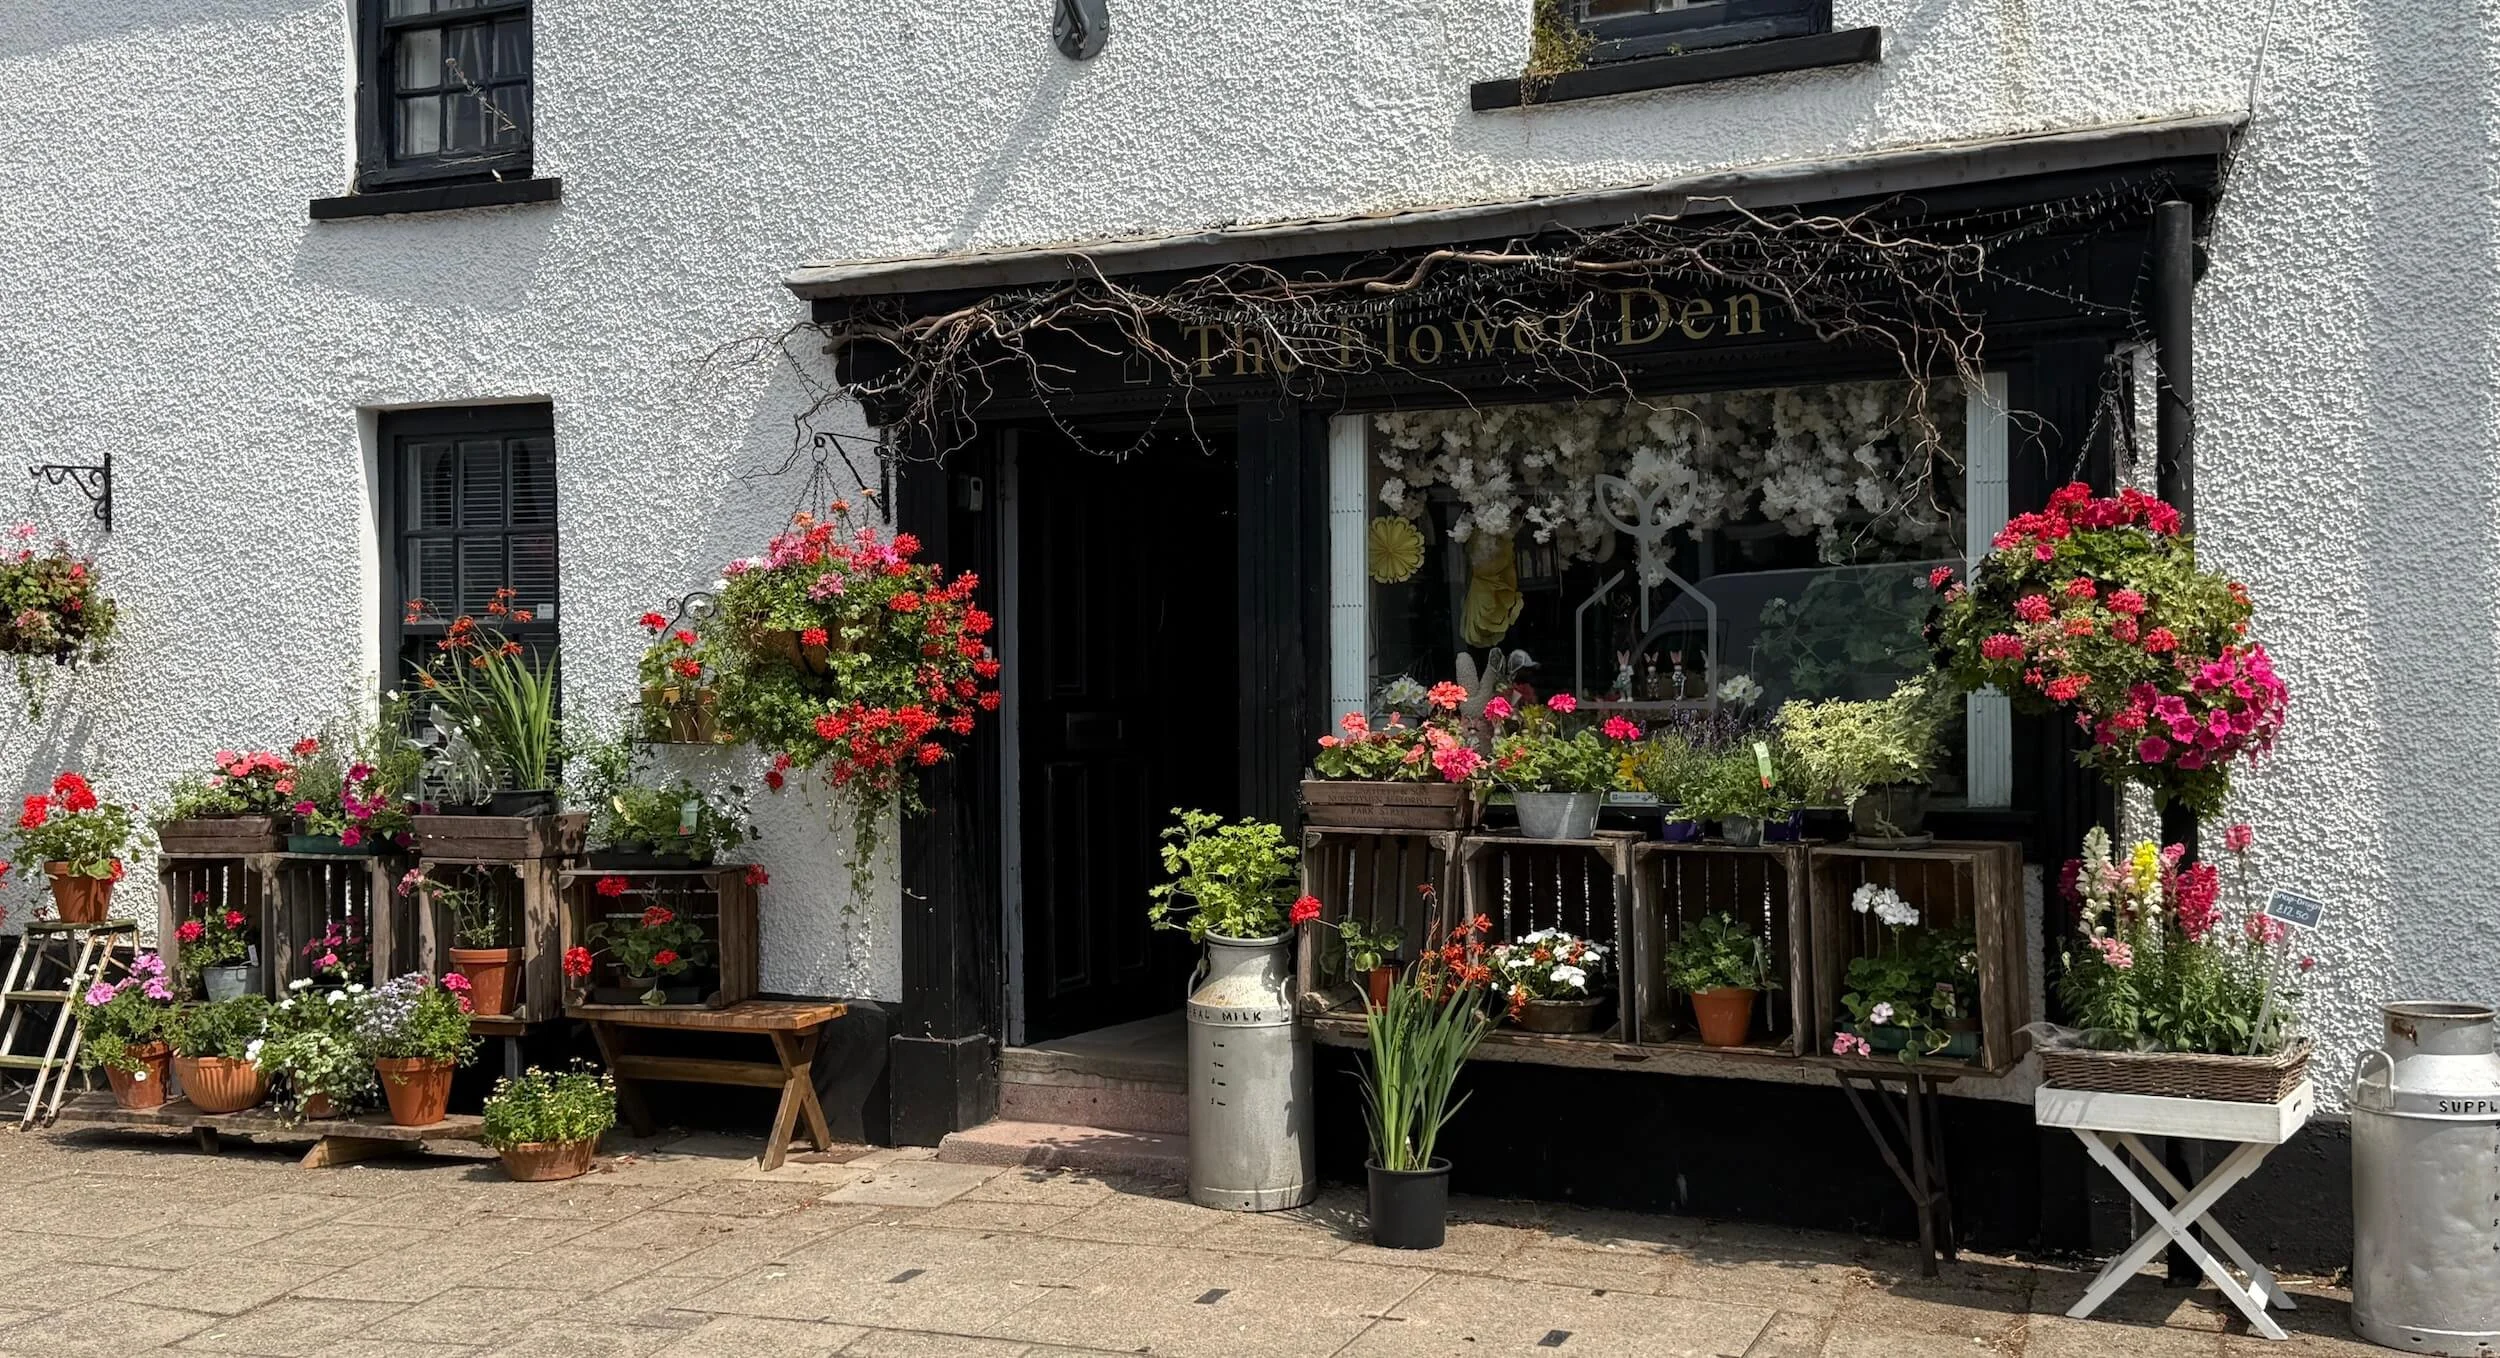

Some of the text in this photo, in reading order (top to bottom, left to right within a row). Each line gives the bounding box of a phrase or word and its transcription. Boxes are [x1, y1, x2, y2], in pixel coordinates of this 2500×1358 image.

[1184, 320, 1301, 377] The
[1616, 287, 1765, 346] Den
[2276, 903, 2309, 920] £12.50
[1222, 1011, 1261, 1021] MILK
